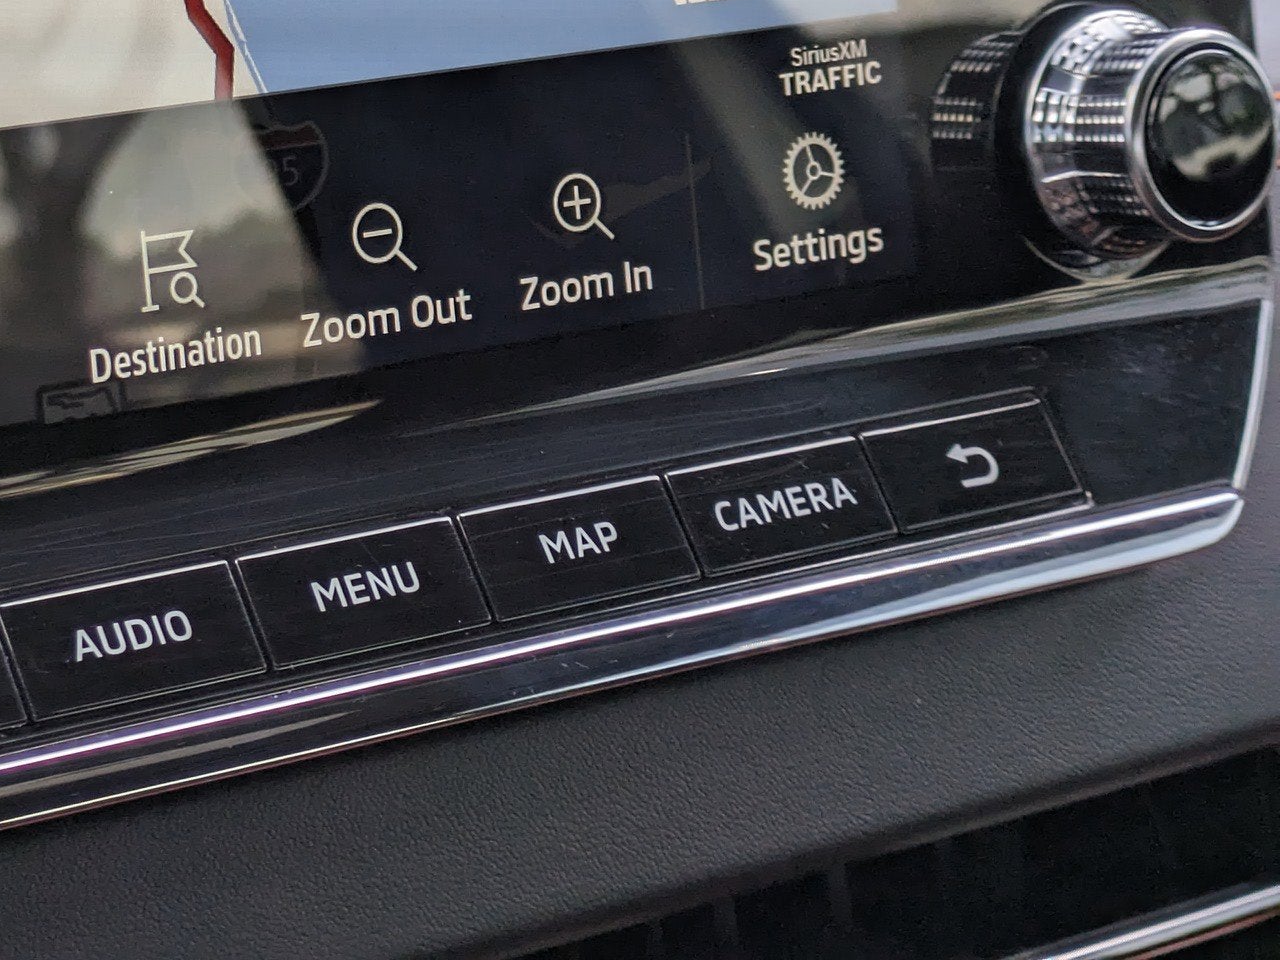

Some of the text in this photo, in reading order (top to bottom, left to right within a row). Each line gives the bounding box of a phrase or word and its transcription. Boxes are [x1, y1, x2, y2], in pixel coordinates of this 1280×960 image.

[778, 60, 882, 96] TRAFFIC
[790, 38, 868, 67] SiriusXM
[752, 227, 884, 273] Settings
[520, 261, 653, 311] Zoom In
[300, 289, 472, 348] Zoom Out
[89, 324, 262, 383] Destination
[714, 476, 857, 533] CAMERA
[539, 520, 619, 565] MAP
[310, 560, 420, 613] MENU
[72, 608, 193, 663] AUDIO
